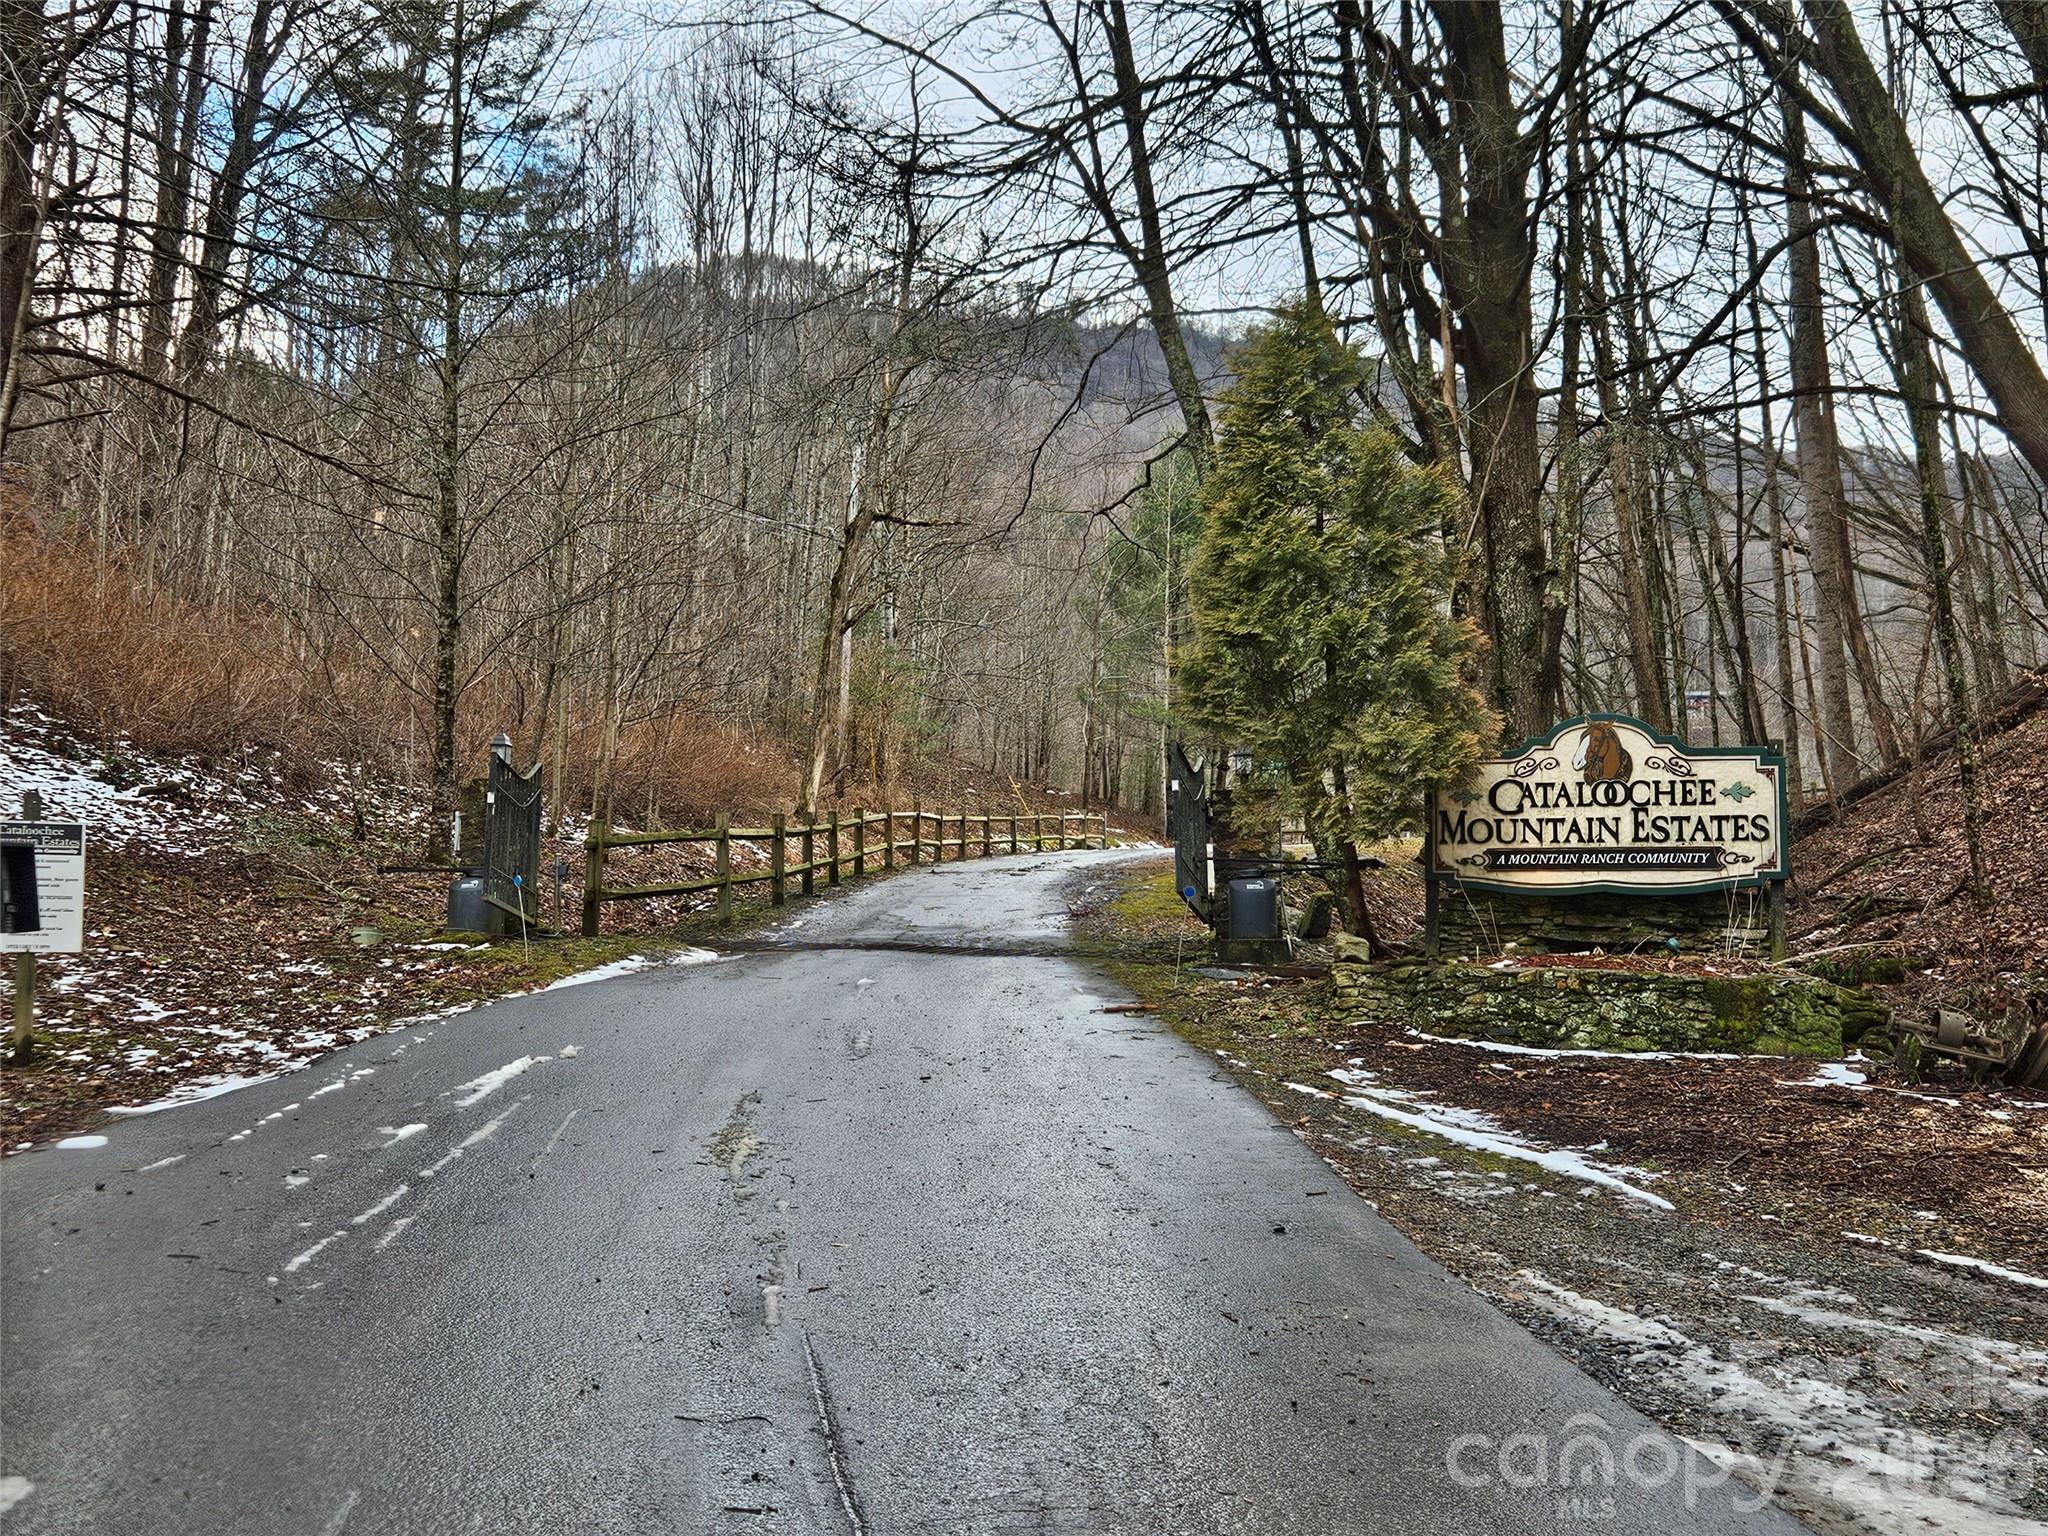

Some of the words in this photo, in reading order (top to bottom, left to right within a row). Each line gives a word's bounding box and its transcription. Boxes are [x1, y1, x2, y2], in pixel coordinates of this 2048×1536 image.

[1489, 779, 1716, 815] CATALOOCHEE
[0, 824, 65, 836] Cataloochee
[1439, 810, 1621, 845] MOUNTAIN
[1631, 807, 1770, 843] ESTATES
[41, 836, 80, 846] Estates
[1497, 854, 1506, 865] A
[1508, 854, 1579, 865] MOUNTAIN
[1580, 854, 1625, 865] RANCH
[1627, 853, 1710, 865] COMMUNITY
